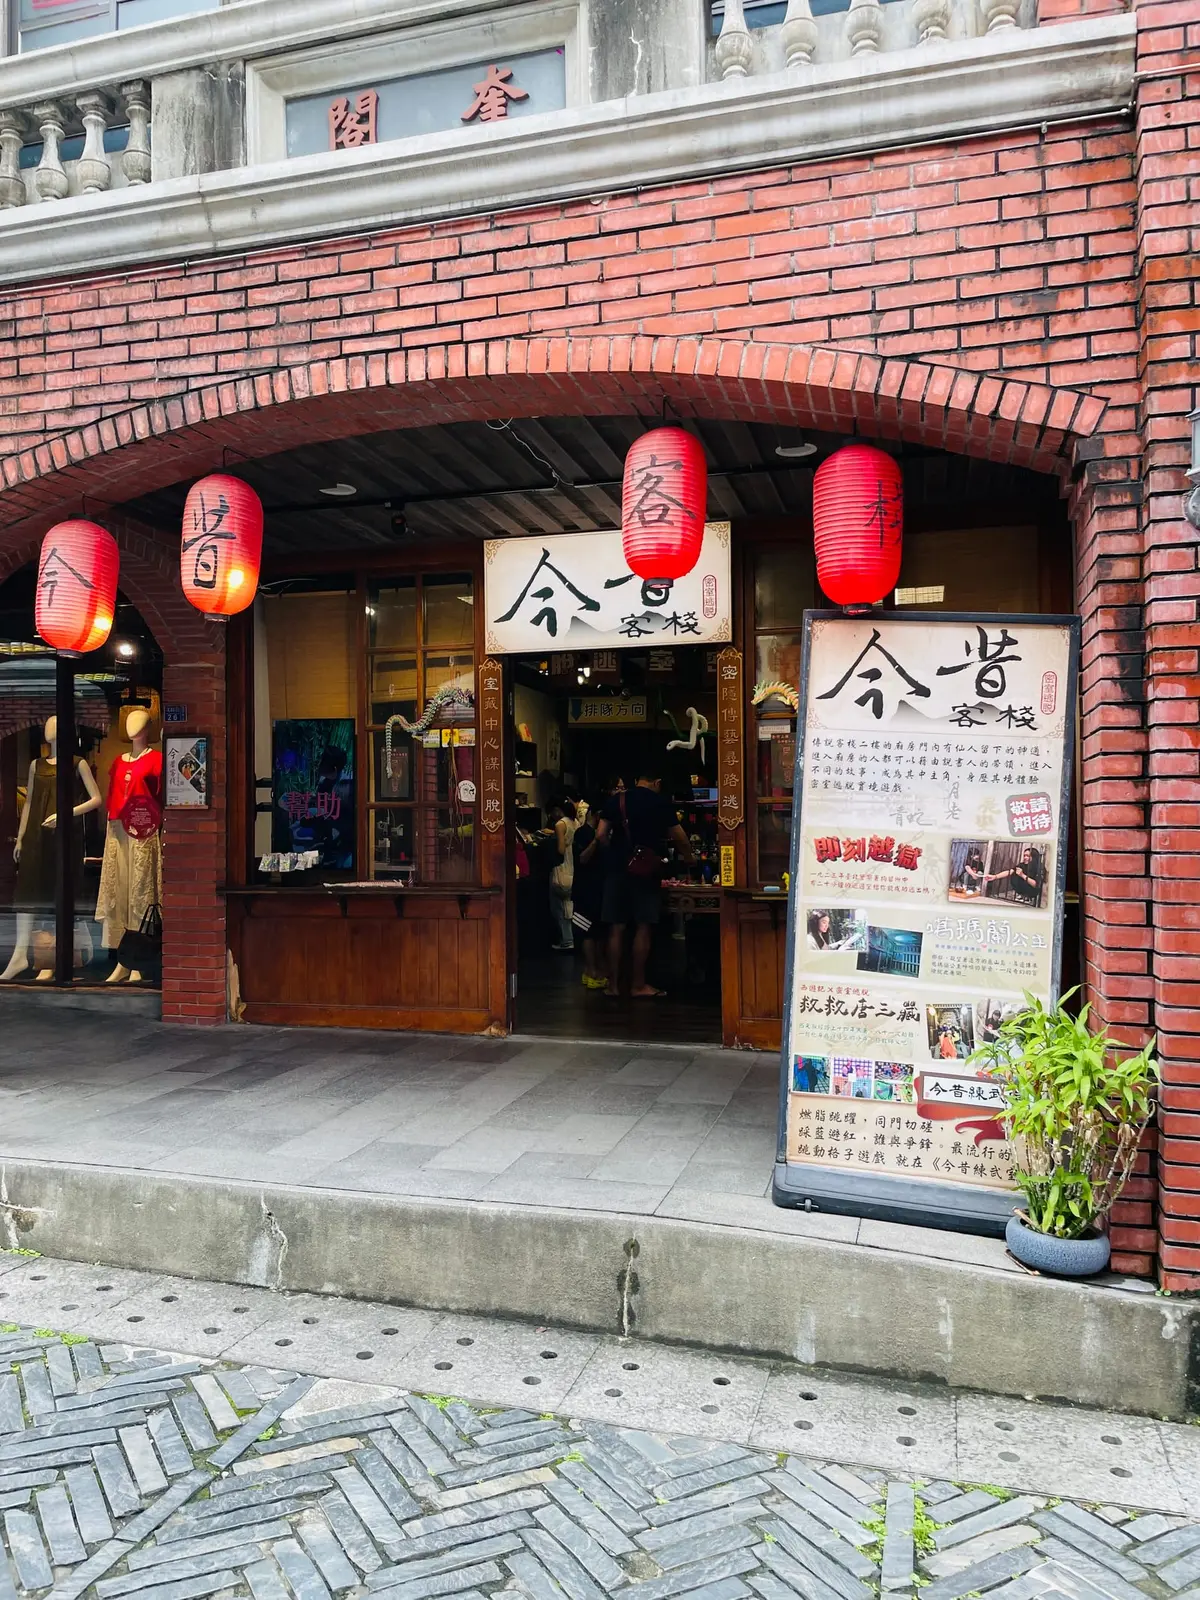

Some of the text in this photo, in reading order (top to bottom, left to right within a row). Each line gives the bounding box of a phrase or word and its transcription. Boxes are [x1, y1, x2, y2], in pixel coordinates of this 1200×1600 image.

[626, 454, 697, 527] 客
[182, 492, 237, 589] 昔
[38, 547, 95, 608] 今
[619, 611, 703, 638] 客棧
[815, 625, 1023, 719] 今昔
[584, 703, 645, 717] 排隊方向
[948, 703, 1039, 731] 客棧
[813, 834, 923, 871] 即刻越獄
[799, 995, 921, 1022] 救救唐三藏
